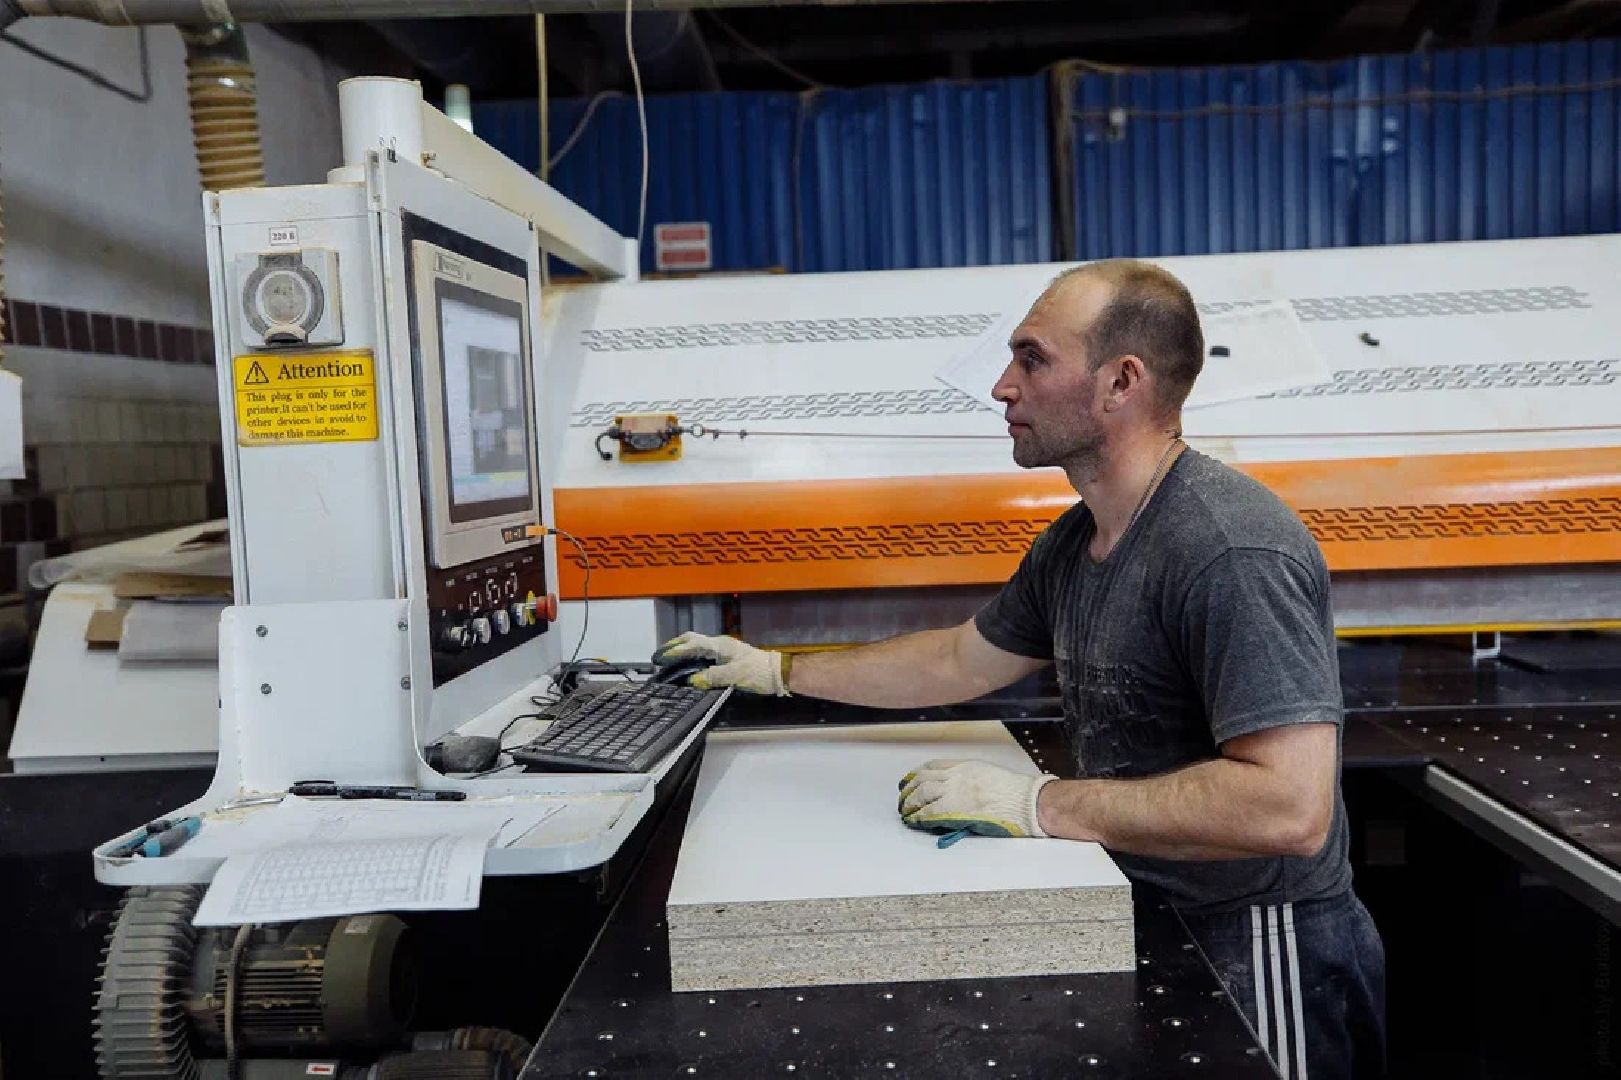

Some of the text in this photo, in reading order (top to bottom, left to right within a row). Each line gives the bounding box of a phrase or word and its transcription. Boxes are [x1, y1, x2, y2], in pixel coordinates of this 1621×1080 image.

[278, 360, 364, 380] Attention
[246, 388, 367, 402] This plug is only for the
[292, 403, 314, 412] can't
[316, 402, 327, 411] be
[330, 401, 351, 410] used
[353, 401, 367, 409] for
[247, 417, 271, 427] other
[277, 417, 310, 425] devices
[249, 430, 284, 439] damage
[287, 429, 303, 437] this
